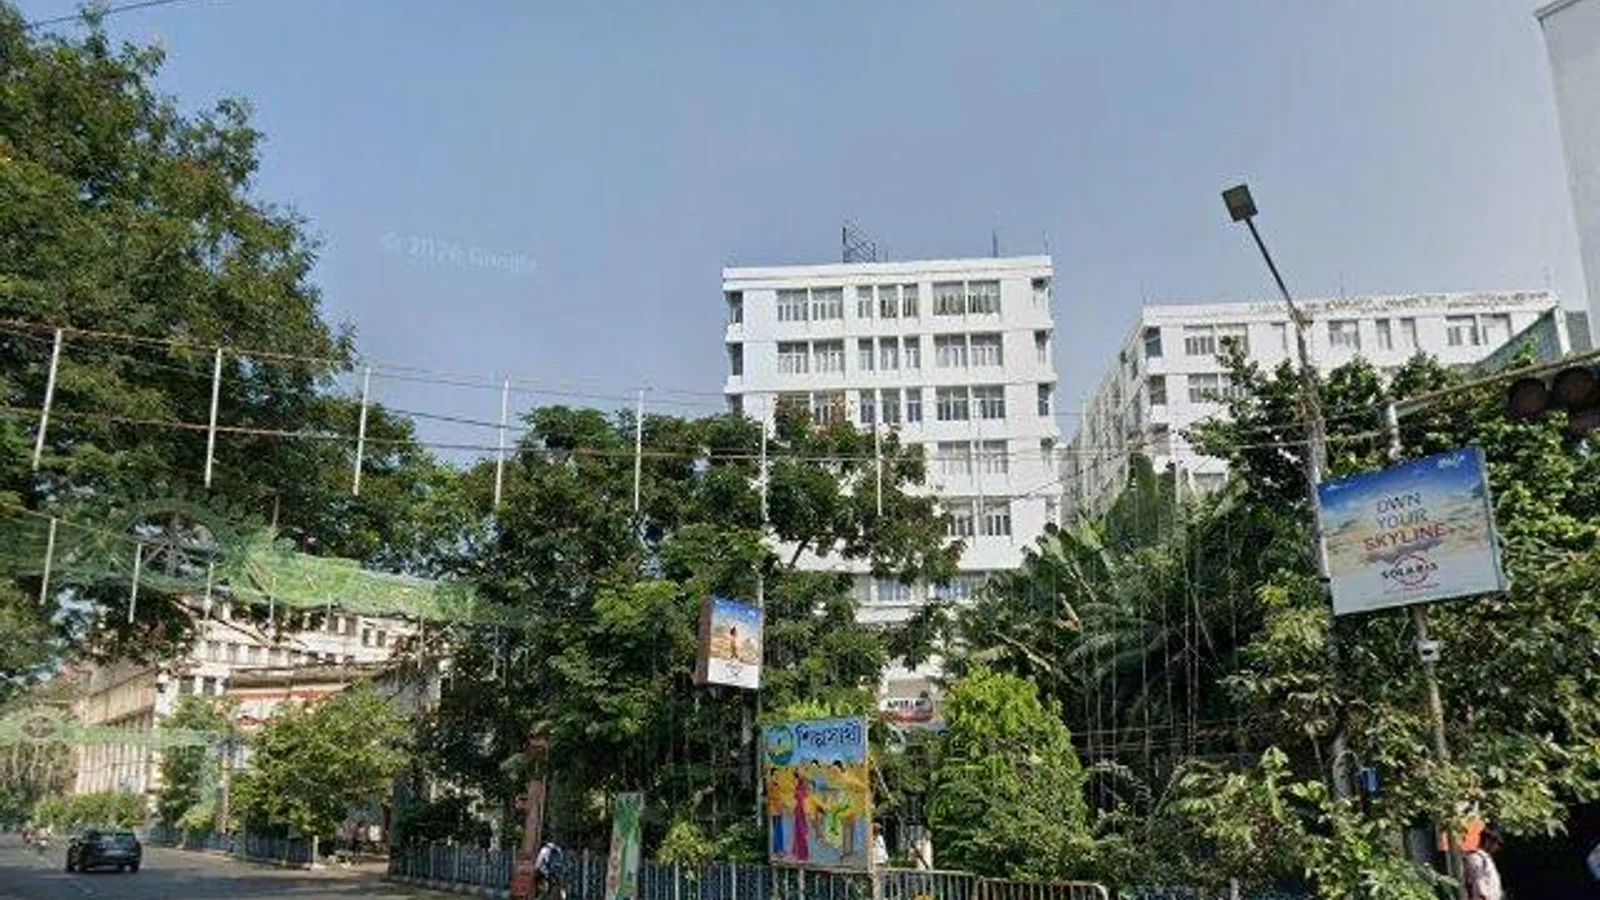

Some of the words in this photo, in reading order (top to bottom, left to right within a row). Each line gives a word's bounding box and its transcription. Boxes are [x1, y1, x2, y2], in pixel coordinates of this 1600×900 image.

[1378, 492, 1421, 514] OWN
[1378, 508, 1428, 528] YOUR
[1363, 522, 1446, 551] SKYLINE
